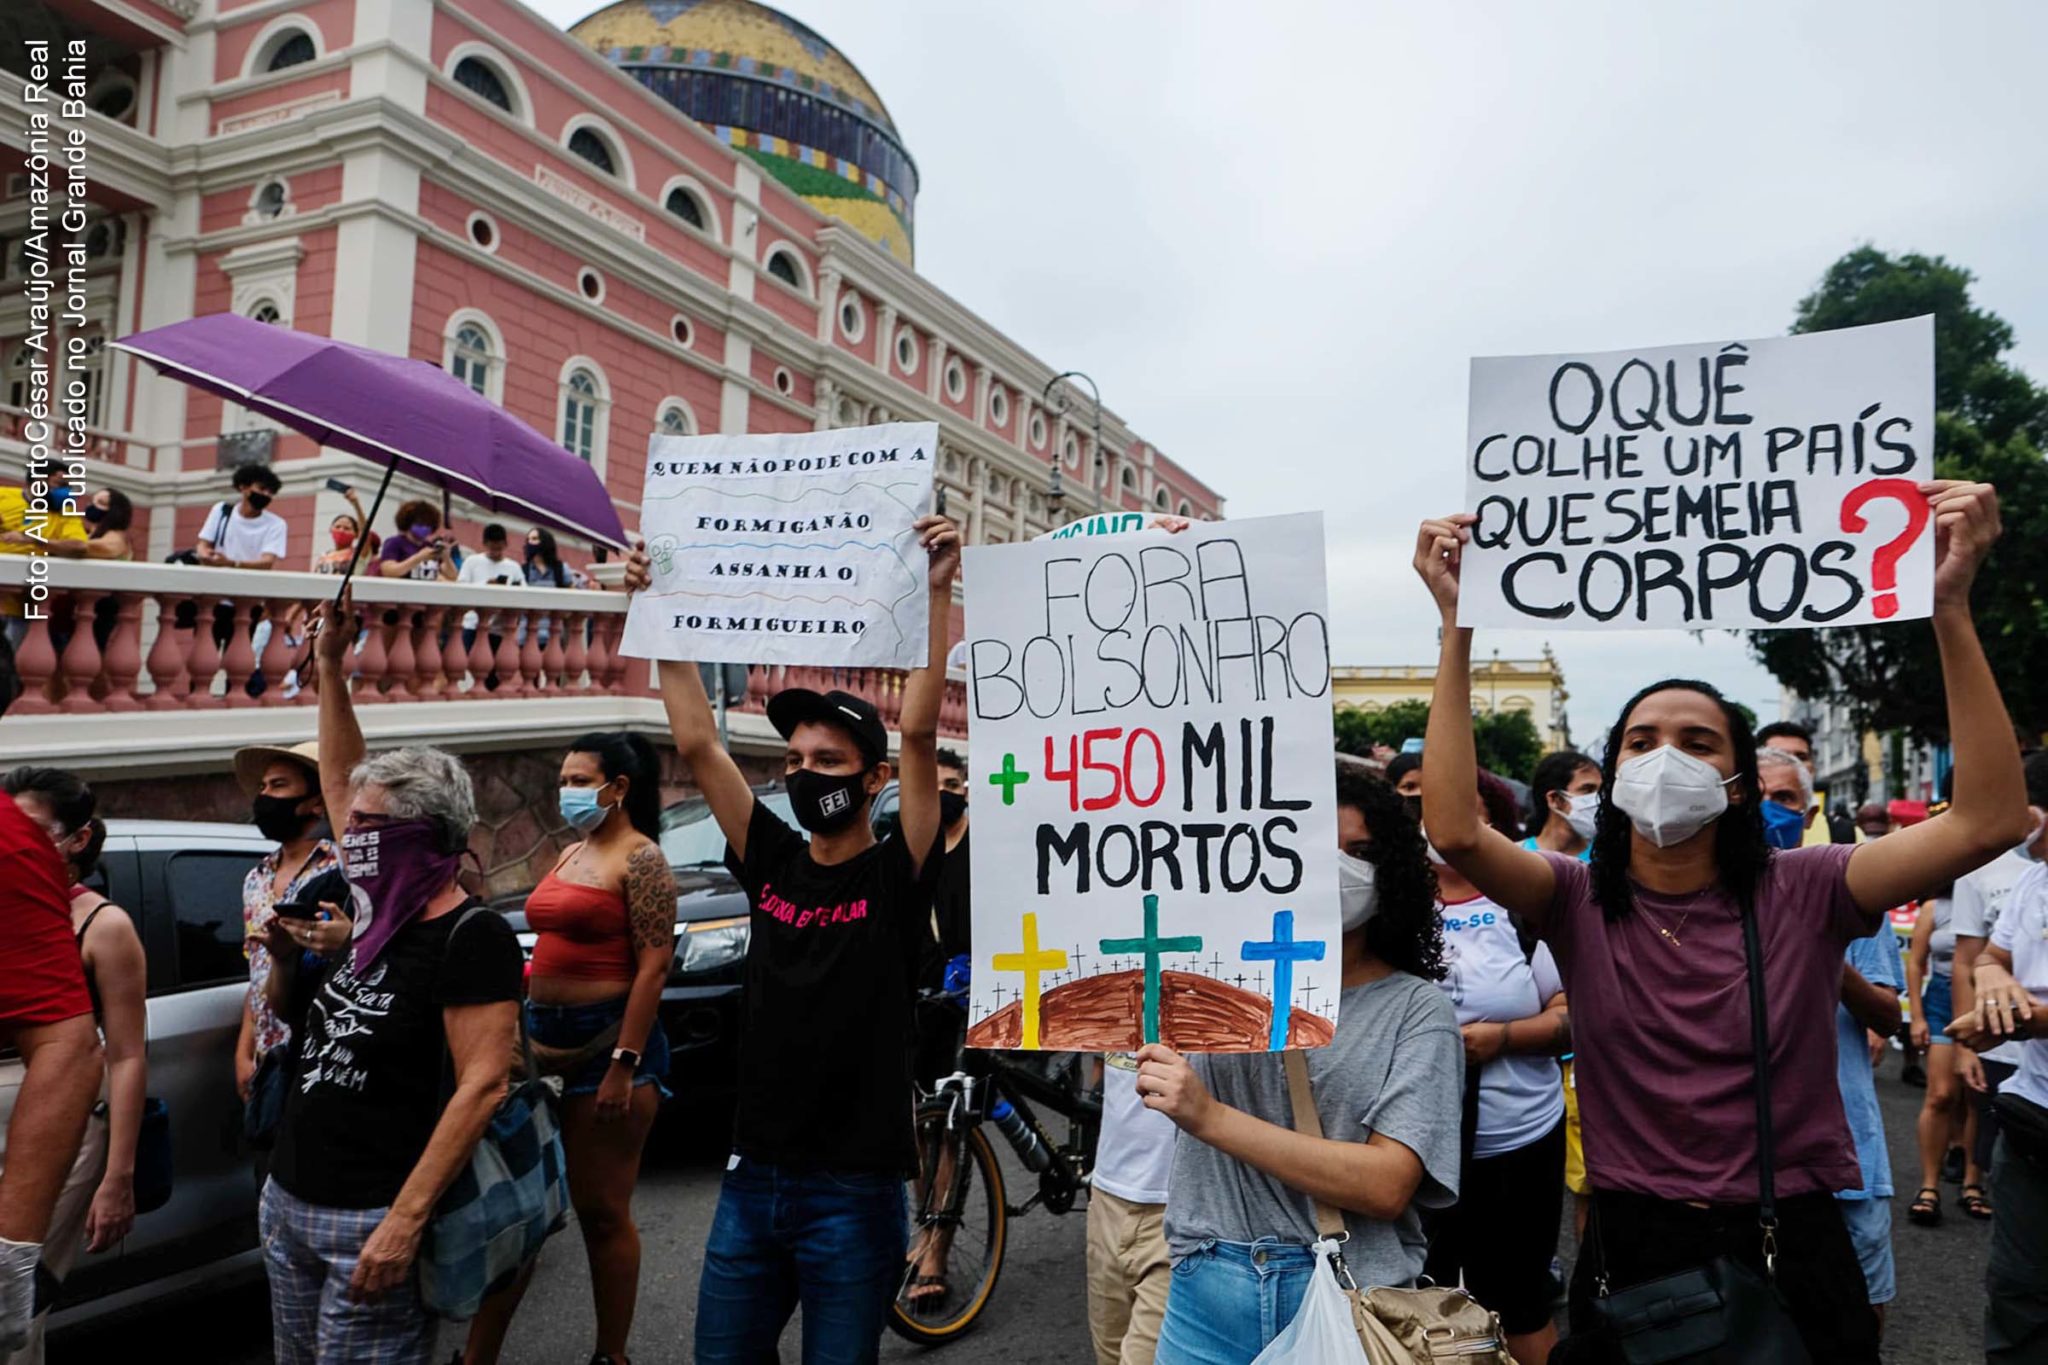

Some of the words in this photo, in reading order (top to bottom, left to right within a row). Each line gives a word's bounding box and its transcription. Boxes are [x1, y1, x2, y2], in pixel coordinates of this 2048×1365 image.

[651, 461, 723, 476] QUEM
[848, 447, 900, 466] COM
[910, 447, 928, 461] A
[1474, 432, 1644, 480] COLHE
[1664, 431, 1742, 479] UM
[1764, 402, 1917, 476] PAÍS
[709, 562, 829, 579] ASSANHA
[837, 566, 853, 580] O
[1045, 539, 1251, 637] FORA
[673, 614, 866, 635] FORMIGUEIRO
[971, 611, 1331, 720] BOLSONARO
[821, 788, 850, 814] FEI
[1182, 716, 1313, 813] MIL
[1035, 816, 1304, 895] MORTOS
